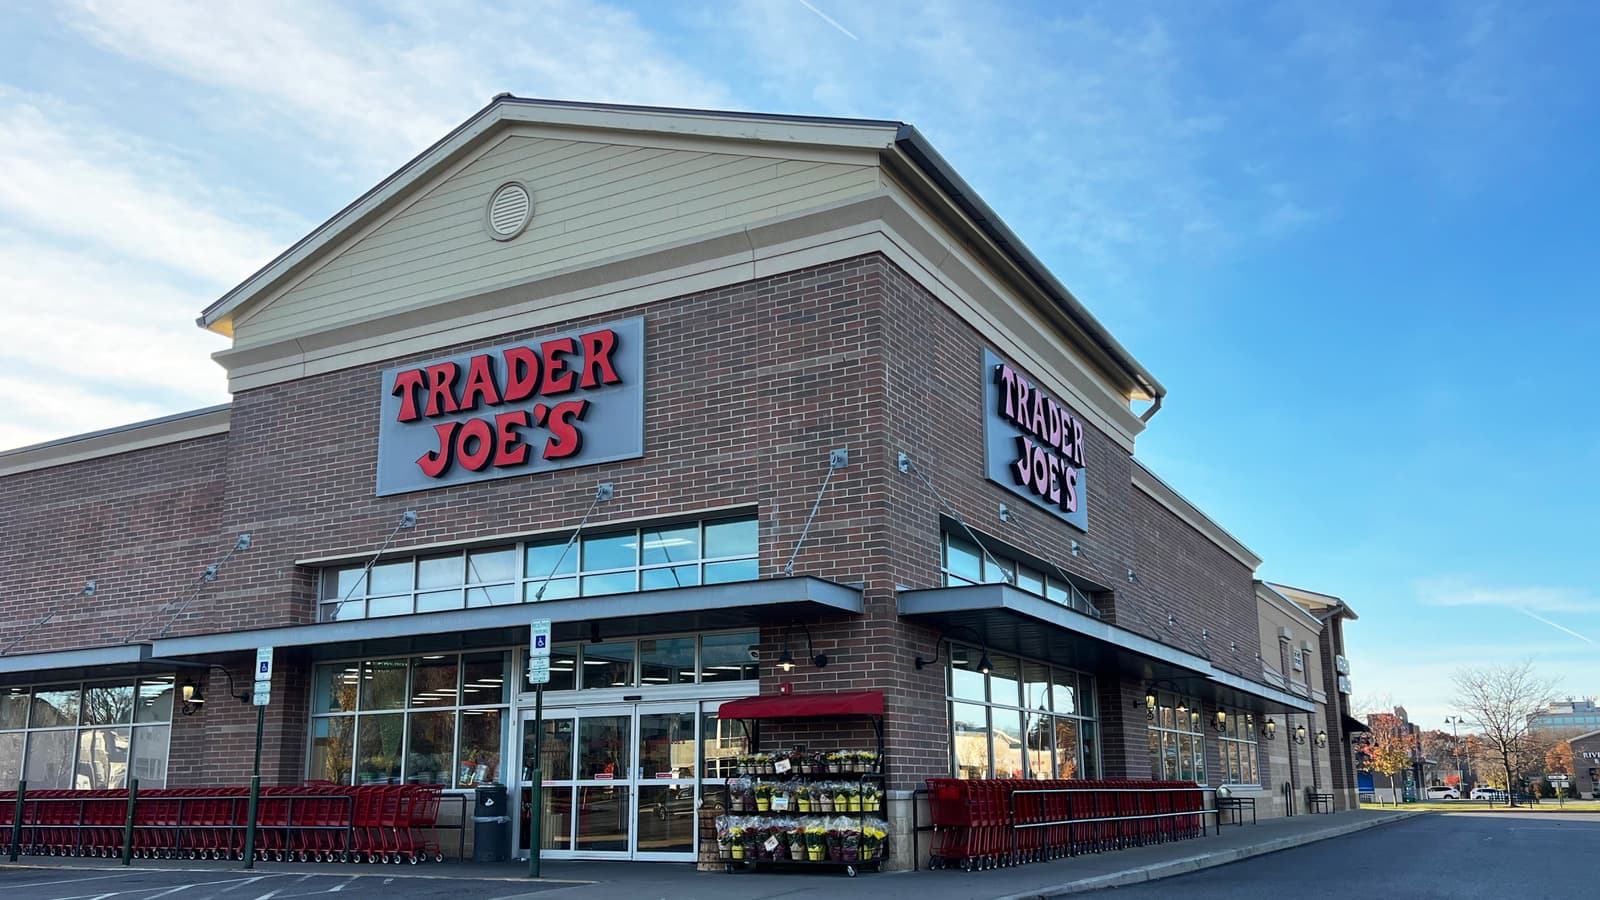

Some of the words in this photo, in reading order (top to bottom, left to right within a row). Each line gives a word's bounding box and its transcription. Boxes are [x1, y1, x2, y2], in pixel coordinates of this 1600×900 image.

[392, 329, 621, 422] TRADER
[997, 364, 1086, 467] TRADER
[416, 400, 589, 478] JOE'S
[1012, 436, 1078, 513] JOE'S
